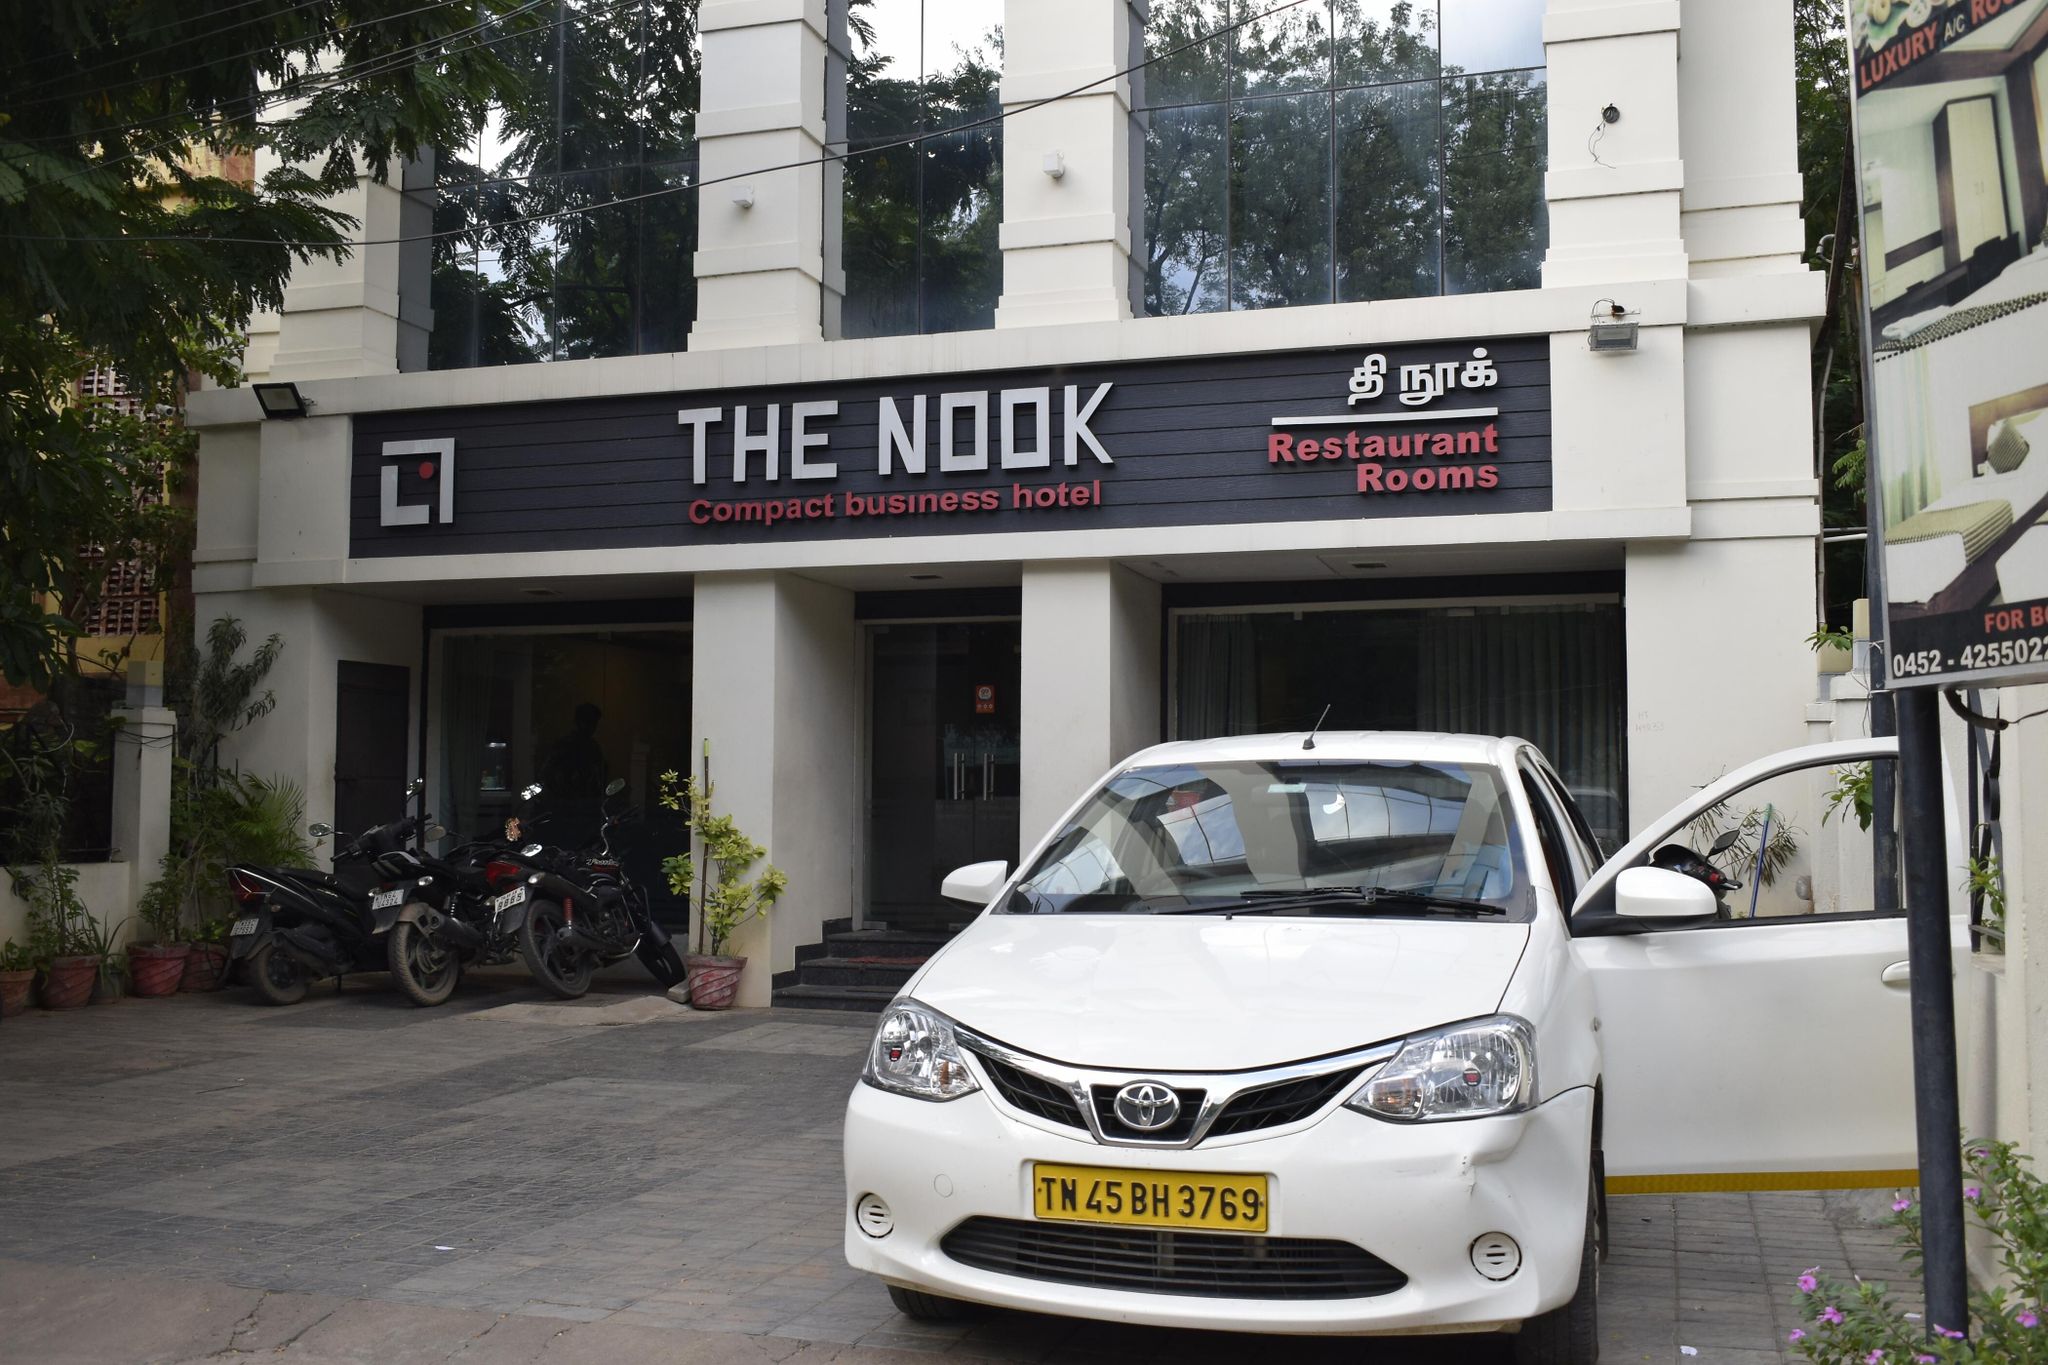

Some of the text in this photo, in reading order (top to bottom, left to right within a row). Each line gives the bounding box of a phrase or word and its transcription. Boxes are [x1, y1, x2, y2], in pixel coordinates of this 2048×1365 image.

[1861, 0, 2015, 90] LUXURY A/C RO
[678, 382, 1115, 485] THE NOOK
[1267, 423, 1499, 463] Restaurant
[1356, 462, 1499, 493] Rooms
[688, 479, 1101, 526] Compact business hotel
[1984, 609, 2025, 634] FOR
[1892, 649, 1942, 678] 0452
[1041, 1176, 1260, 1222] TN 45 BH 3769
